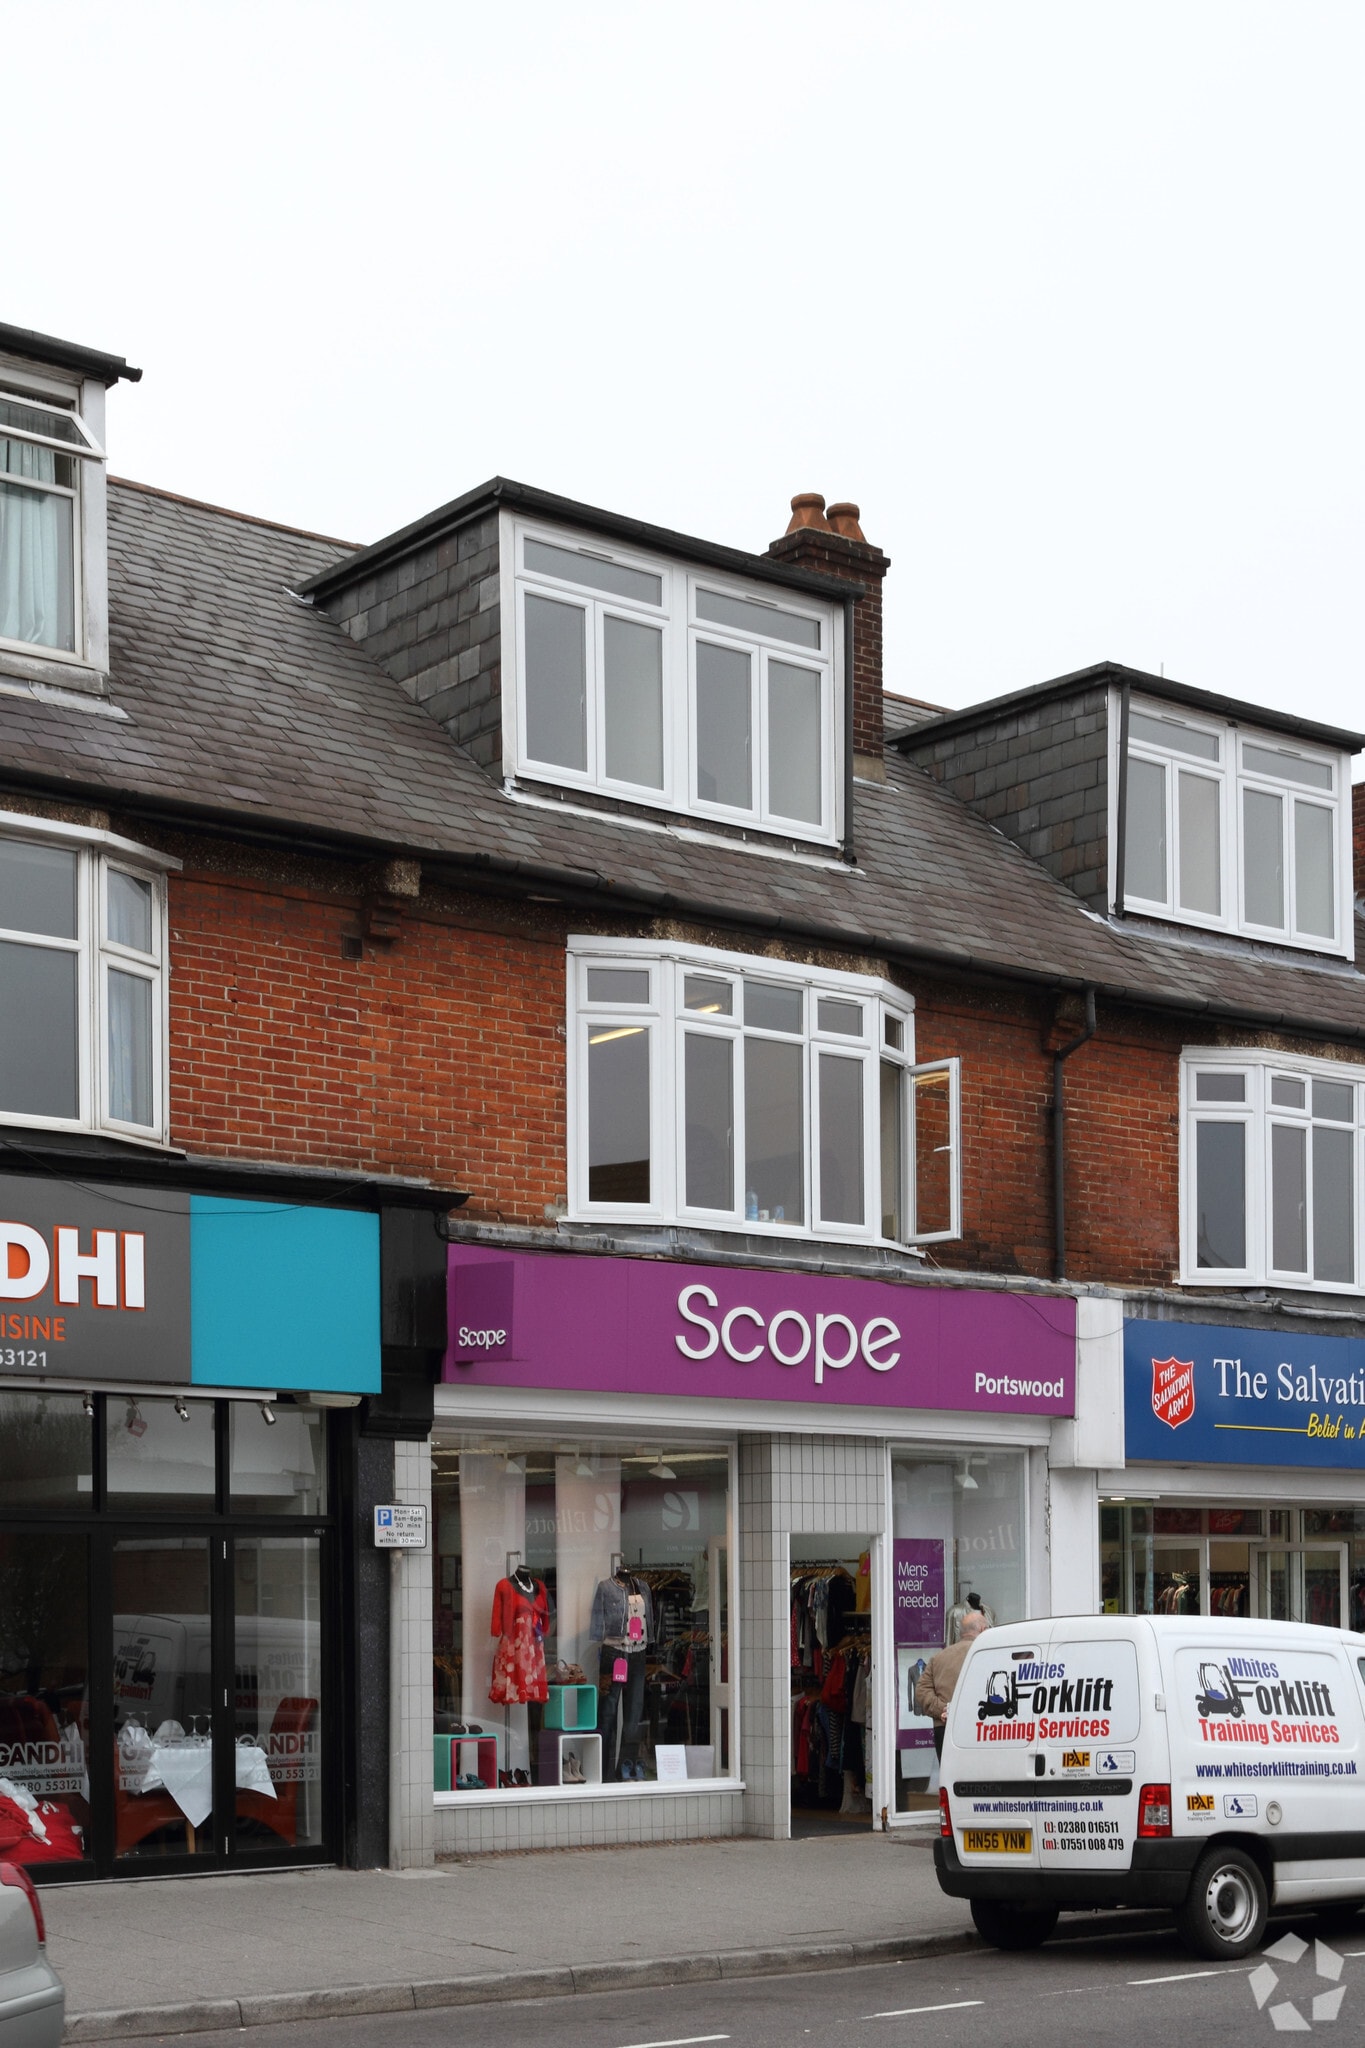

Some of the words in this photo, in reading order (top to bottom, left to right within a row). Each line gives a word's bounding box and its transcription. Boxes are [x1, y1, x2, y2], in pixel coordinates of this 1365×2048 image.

[458, 1326, 506, 1350] Scope
[675, 1284, 901, 1384] Scope
[975, 1372, 1064, 1398] Portswood
[1159, 1364, 1176, 1387] THE
[1213, 1359, 1268, 1399] The
[1154, 1368, 1190, 1411] SALVATION
[1167, 1388, 1190, 1420] ARMY
[1307, 1413, 1343, 1439] Belief
[1344, 1423, 1356, 1439] in
[898, 1561, 929, 1577] Mens
[897, 1579, 925, 1592] wear
[898, 1593, 939, 1608] needed
[1018, 1662, 1066, 1681] Whites
[1227, 1657, 1280, 1679] Whites
[976, 1720, 1036, 1742] Training
[1038, 1717, 1110, 1739] Services
[1198, 1718, 1270, 1745] Training
[1270, 1720, 1340, 1744] Services
[1062, 1749, 1090, 1768] IPAF
[1195, 1760, 1357, 1778] www.whitesforklifttraining.co.uk
[45, 1780, 82, 1792] 553121
[973, 1800, 1104, 1814] www.whitesforklifttraining.co.uk
[1186, 1792, 1215, 1811] IPAF
[1044, 1821, 1057, 1835] (t):
[1057, 1821, 1086, 1834] 02380
[1088, 1821, 1119, 1834] 016511
[968, 1833, 999, 1850] HN56
[1002, 1832, 1026, 1850] VNW
[1042, 1838, 1060, 1851] (m):
[1060, 1839, 1087, 1851] 07551
[1088, 1839, 1106, 1851] 008
[1107, 1838, 1124, 1851] 479
